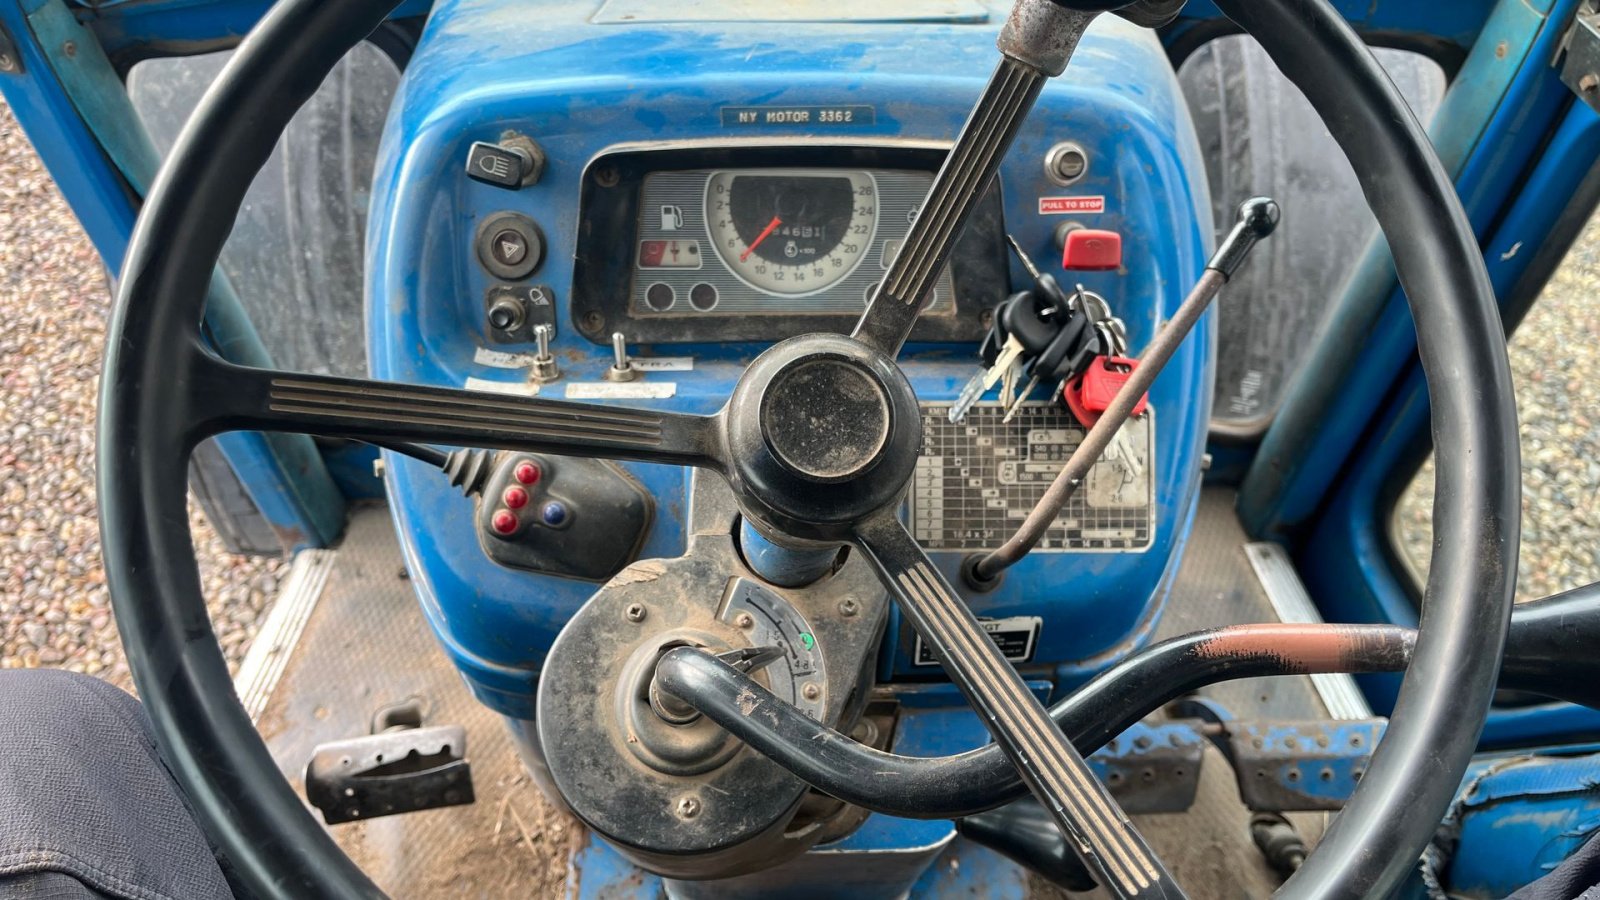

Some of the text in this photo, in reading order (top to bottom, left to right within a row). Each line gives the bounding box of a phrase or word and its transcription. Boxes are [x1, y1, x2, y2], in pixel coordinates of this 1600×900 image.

[738, 110, 853, 123] NY MOTOR 3362
[716, 184, 724, 194] 0
[858, 186, 872, 196] 26
[716, 201, 724, 210] 2
[1042, 200, 1101, 210] PULL TO STOP
[858, 206, 873, 216] 24
[719, 219, 726, 228] 4
[854, 225, 868, 235] 22
[844, 244, 858, 254] 20
[831, 257, 842, 268] 18
[754, 264, 767, 275] 10
[812, 267, 824, 278] 16
[773, 271, 785, 281] 12
[794, 272, 805, 282] 14
